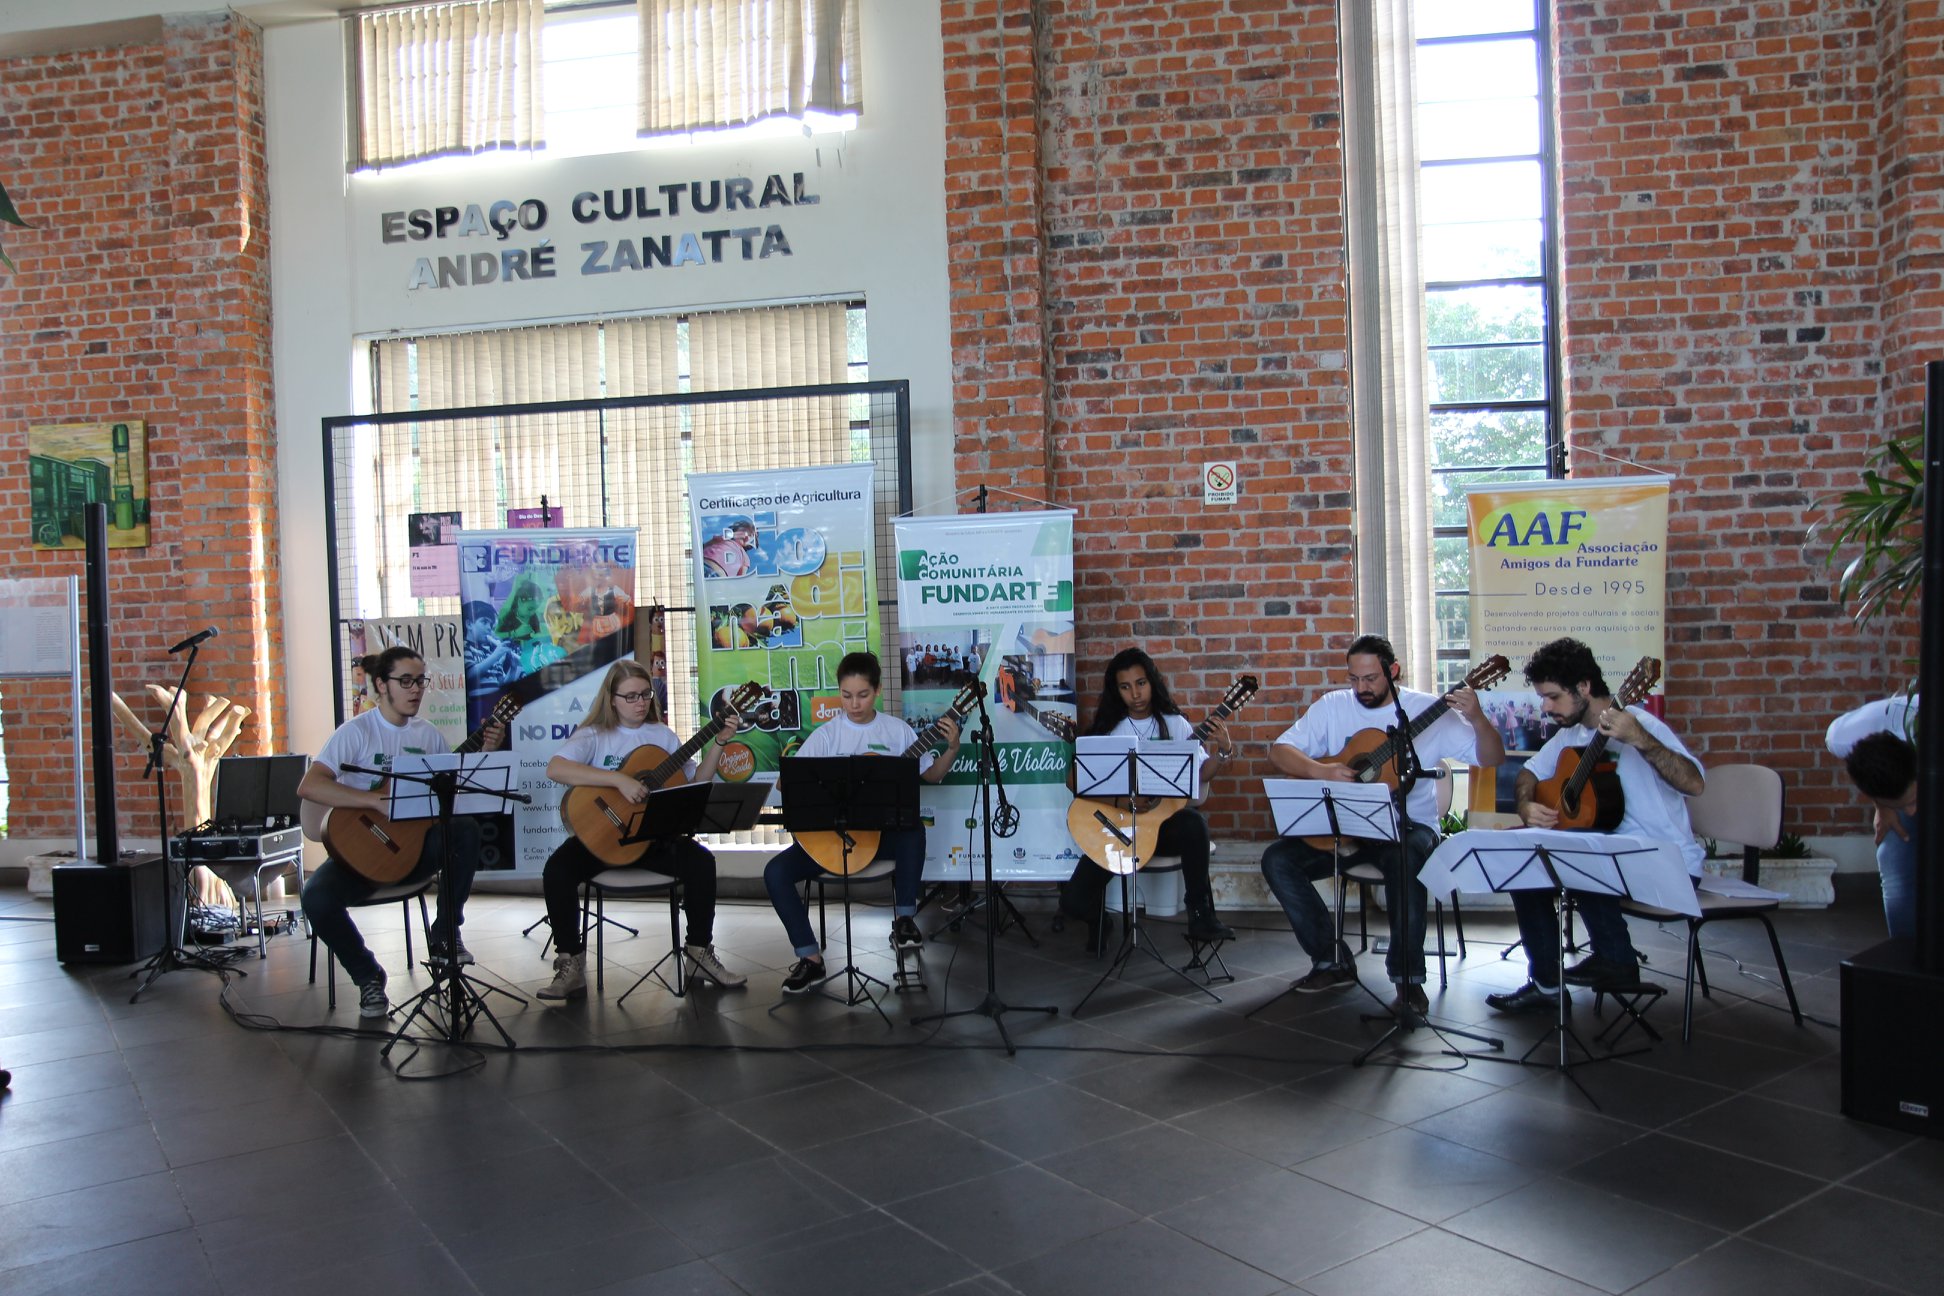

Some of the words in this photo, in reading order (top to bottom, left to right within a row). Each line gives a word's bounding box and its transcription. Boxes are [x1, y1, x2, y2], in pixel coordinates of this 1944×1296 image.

[382, 199, 549, 243] ESPAÇO
[571, 171, 821, 224] CULTURAL
[408, 238, 557, 290] ANDRÉ
[580, 224, 793, 275] ZANATTA
[775, 493, 790, 505] de
[792, 490, 861, 506] Agricultura
[1487, 510, 1587, 548] AAF
[701, 511, 826, 581] Bio
[1577, 541, 1658, 556] Associação
[918, 552, 959, 567] AÇÃO
[1500, 558, 1550, 571] Amigos
[1554, 557, 1571, 569] da
[1576, 556, 1639, 569] Fundarte
[918, 564, 1023, 580] COMUNITÁRIA
[1535, 582, 1593, 596] Desde
[1603, 580, 1645, 595] 1995
[1484, 609, 1544, 617] Desenvolvendo
[1546, 609, 1580, 619] projetos
[1582, 609, 1619, 617] culturais
[1630, 609, 1660, 617] sociais
[1484, 625, 1527, 633] Captando
[1643, 624, 1655, 632] de
[519, 725, 547, 741] NO
[1011, 747, 1066, 774] Violão
[522, 781, 533, 789] 51
